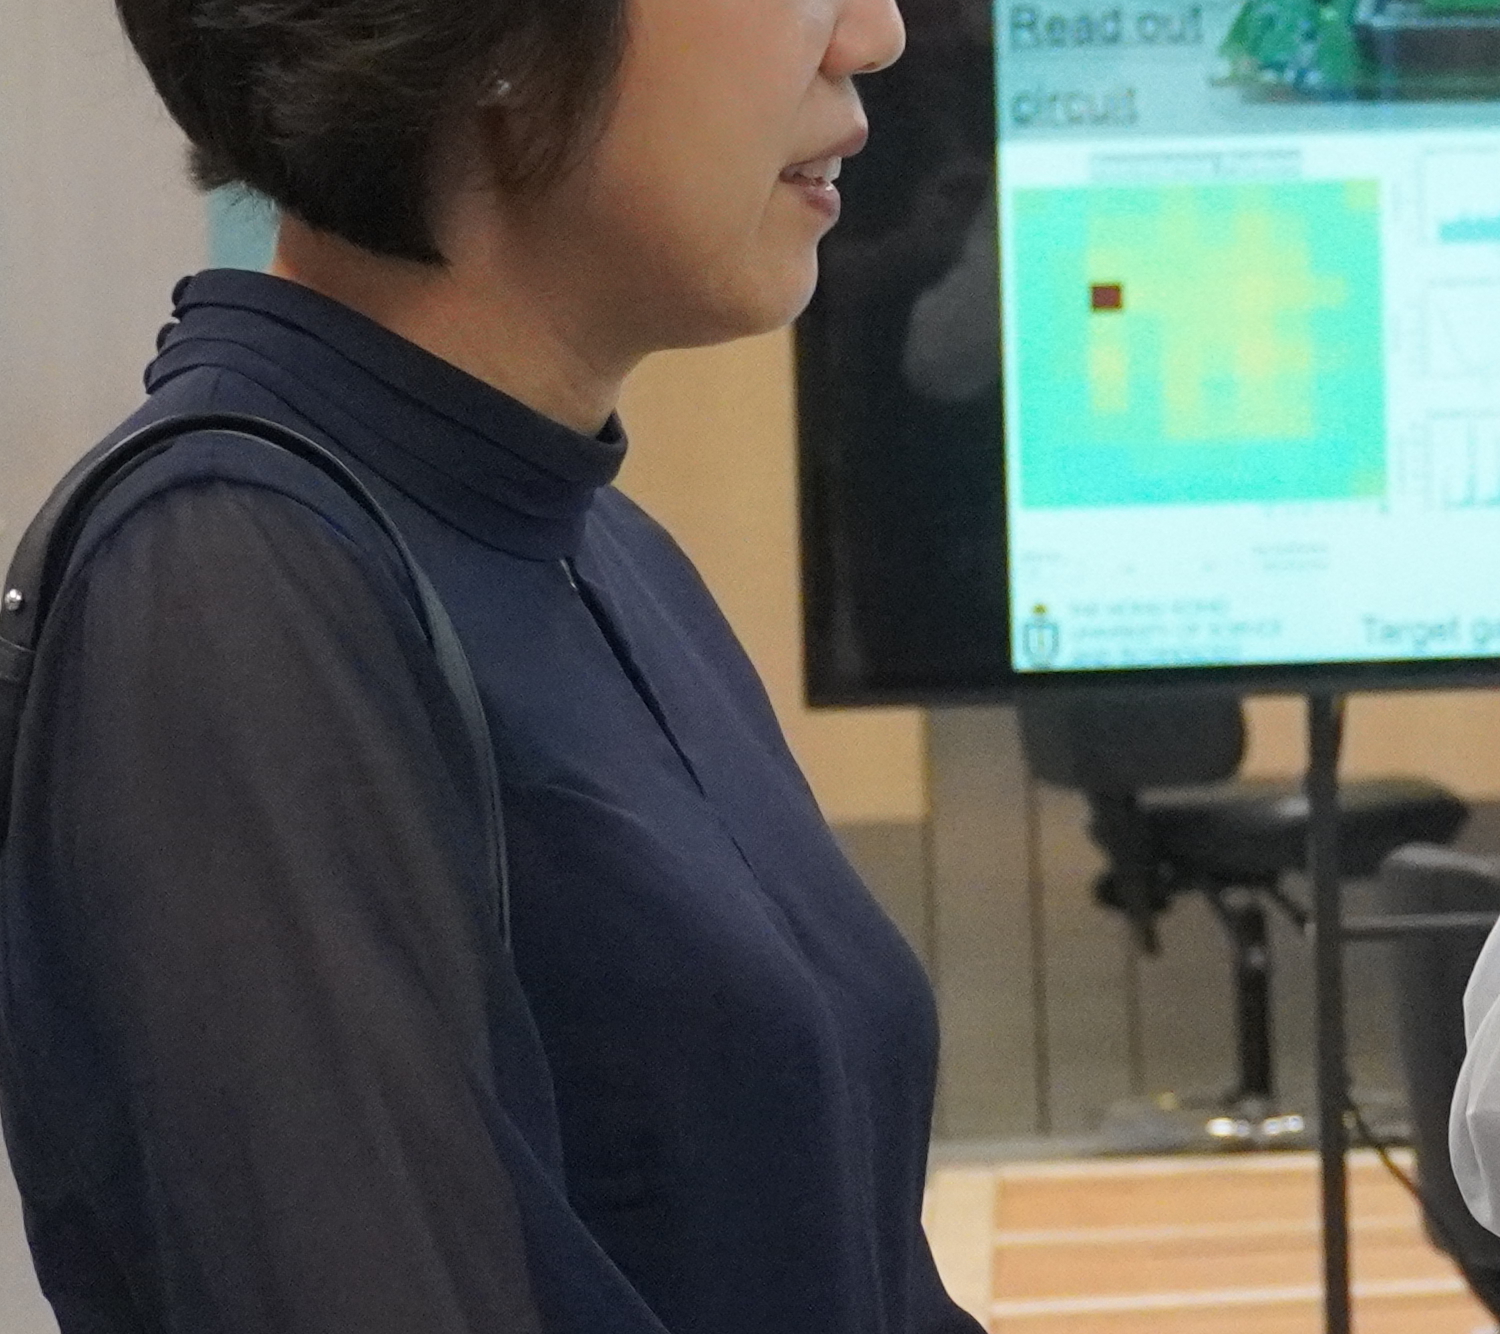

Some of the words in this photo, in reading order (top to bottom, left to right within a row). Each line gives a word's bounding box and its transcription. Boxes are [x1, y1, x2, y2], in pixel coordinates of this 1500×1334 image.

[1009, 2, 1122, 51] Read
[1136, 3, 1204, 47] out
[1362, 611, 1461, 653] Target
